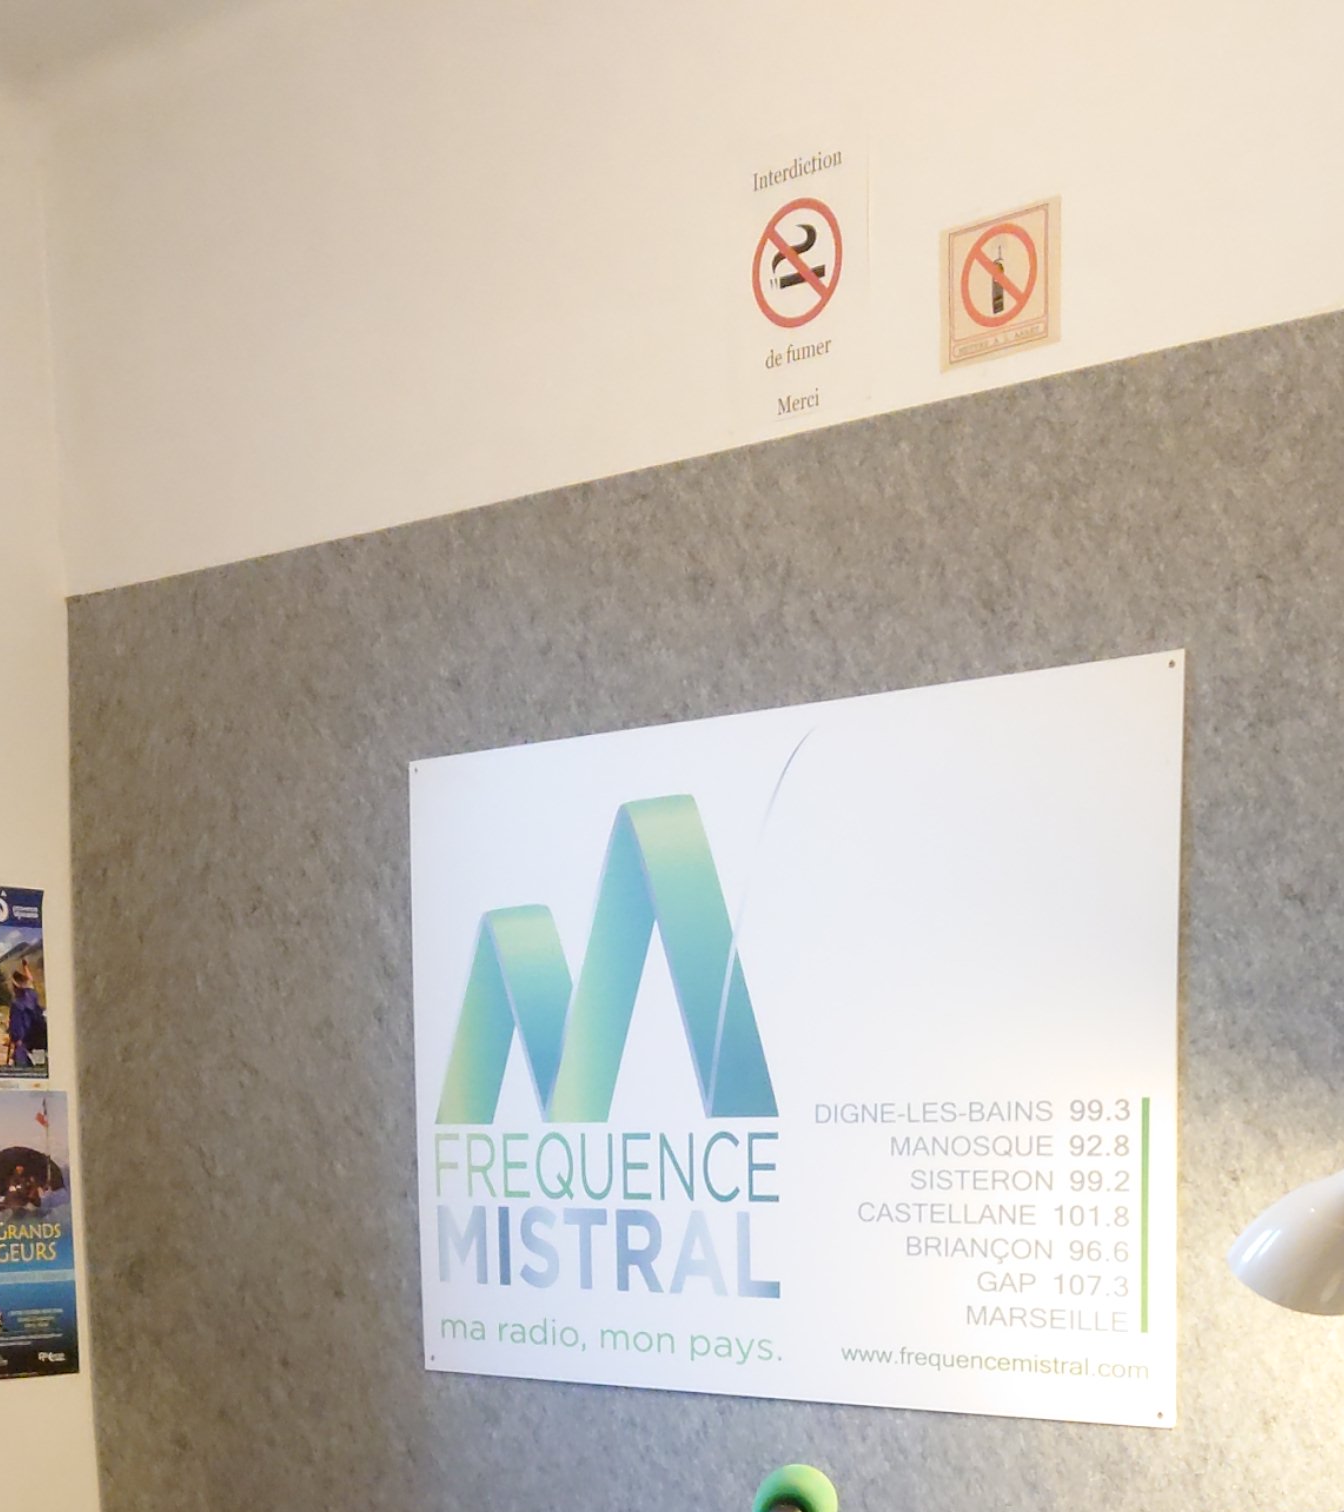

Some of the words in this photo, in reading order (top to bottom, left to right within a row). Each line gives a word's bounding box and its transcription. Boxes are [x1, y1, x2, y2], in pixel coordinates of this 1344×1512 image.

[753, 150, 843, 192] Interdiction
[765, 349, 783, 370] de
[786, 338, 832, 365] fumer
[777, 388, 820, 416] Merci
[814, 1100, 1054, 1124] DIGNE-LES-BAINS
[1069, 1099, 1131, 1122] 99.3
[890, 1135, 1054, 1158] MANOSQUE
[1069, 1134, 1130, 1157] 92.8
[434, 1131, 780, 1203] FREQUENCE
[910, 1169, 1054, 1191] SISTERON
[1069, 1169, 1130, 1192] 99.2
[857, 1201, 1037, 1226] CASTELLANE
[1054, 1204, 1130, 1227] 101.8
[437, 1205, 781, 1299] MISTRAL
[906, 1236, 1053, 1264] BRIANÇON
[1069, 1239, 1130, 1263] 96.6
[976, 1271, 1036, 1294] GAP
[1054, 1274, 1130, 1298] 107.3
[966, 1305, 1129, 1333] MARSEILLE
[440, 1317, 486, 1342] ma
[498, 1317, 587, 1351] radio,
[599, 1325, 676, 1354] mon
[689, 1333, 783, 1365] pays.
[841, 1347, 1150, 1379] www.frequencemistral.com
